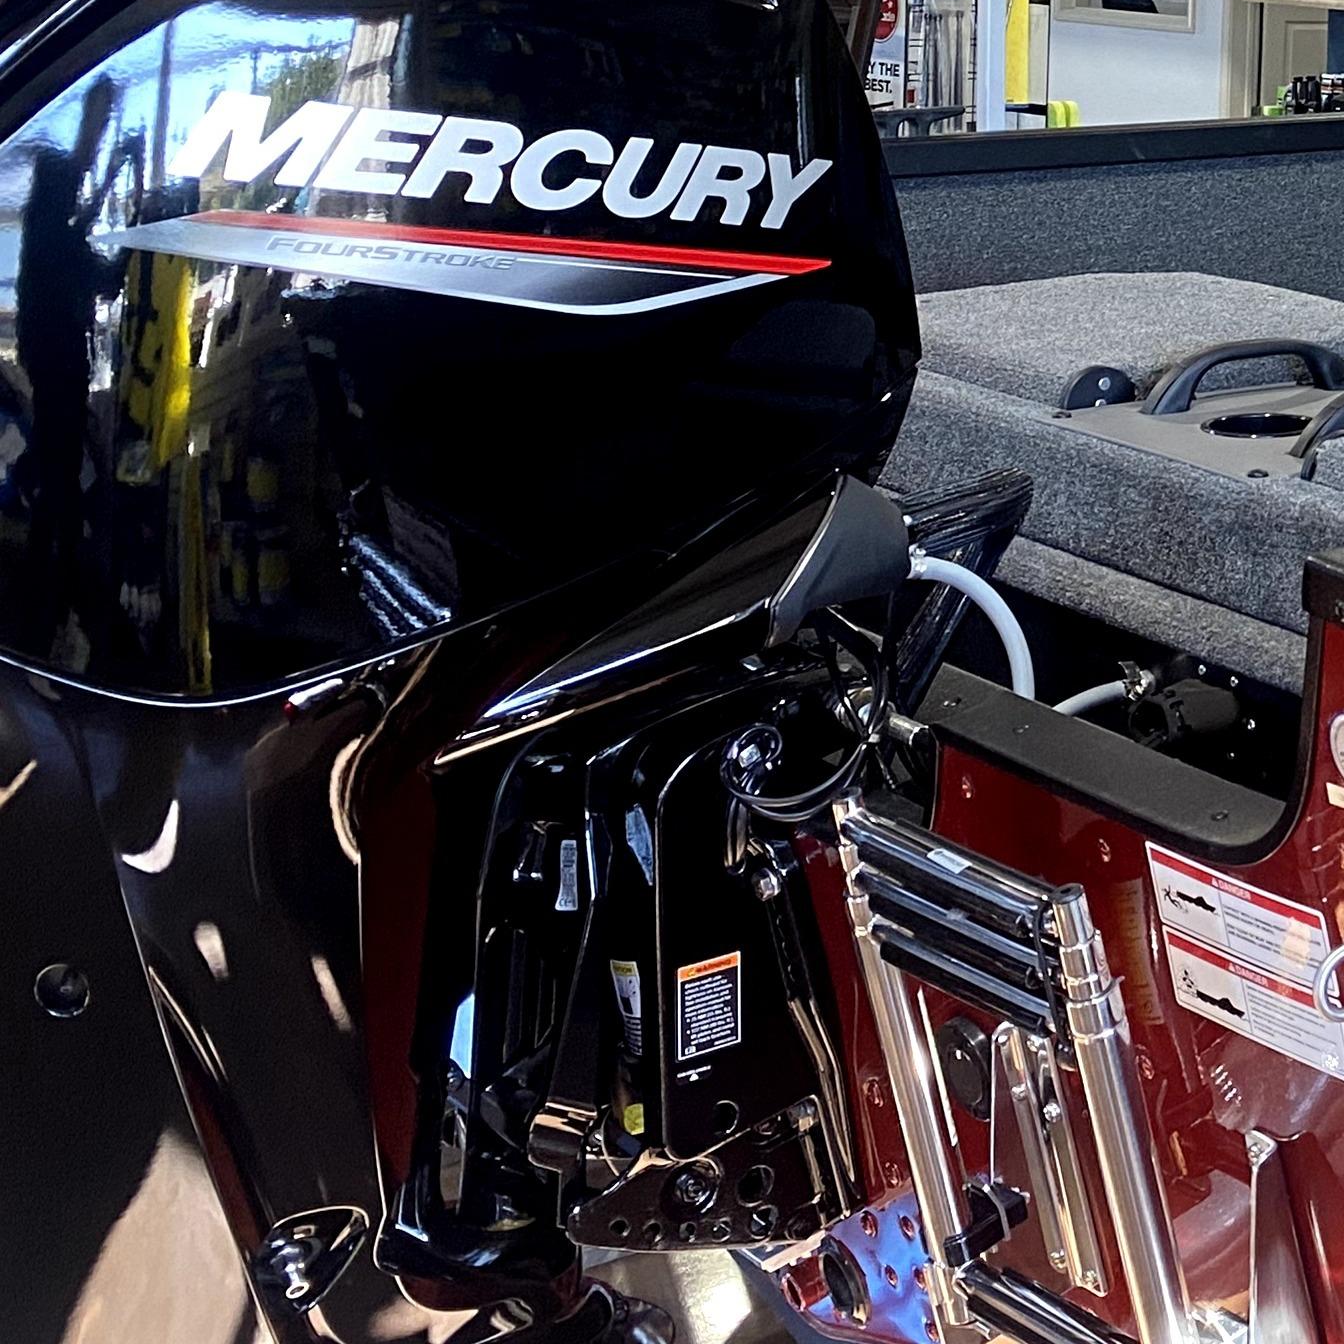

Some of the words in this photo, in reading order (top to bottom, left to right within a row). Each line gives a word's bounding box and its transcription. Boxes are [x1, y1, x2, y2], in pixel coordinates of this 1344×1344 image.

[879, 63, 900, 77] THE
[166, 90, 833, 230] MERCURY
[266, 236, 518, 272] FOURSTROKE
[1218, 878, 1252, 901] DANGER
[1234, 965, 1269, 988] DANGER
